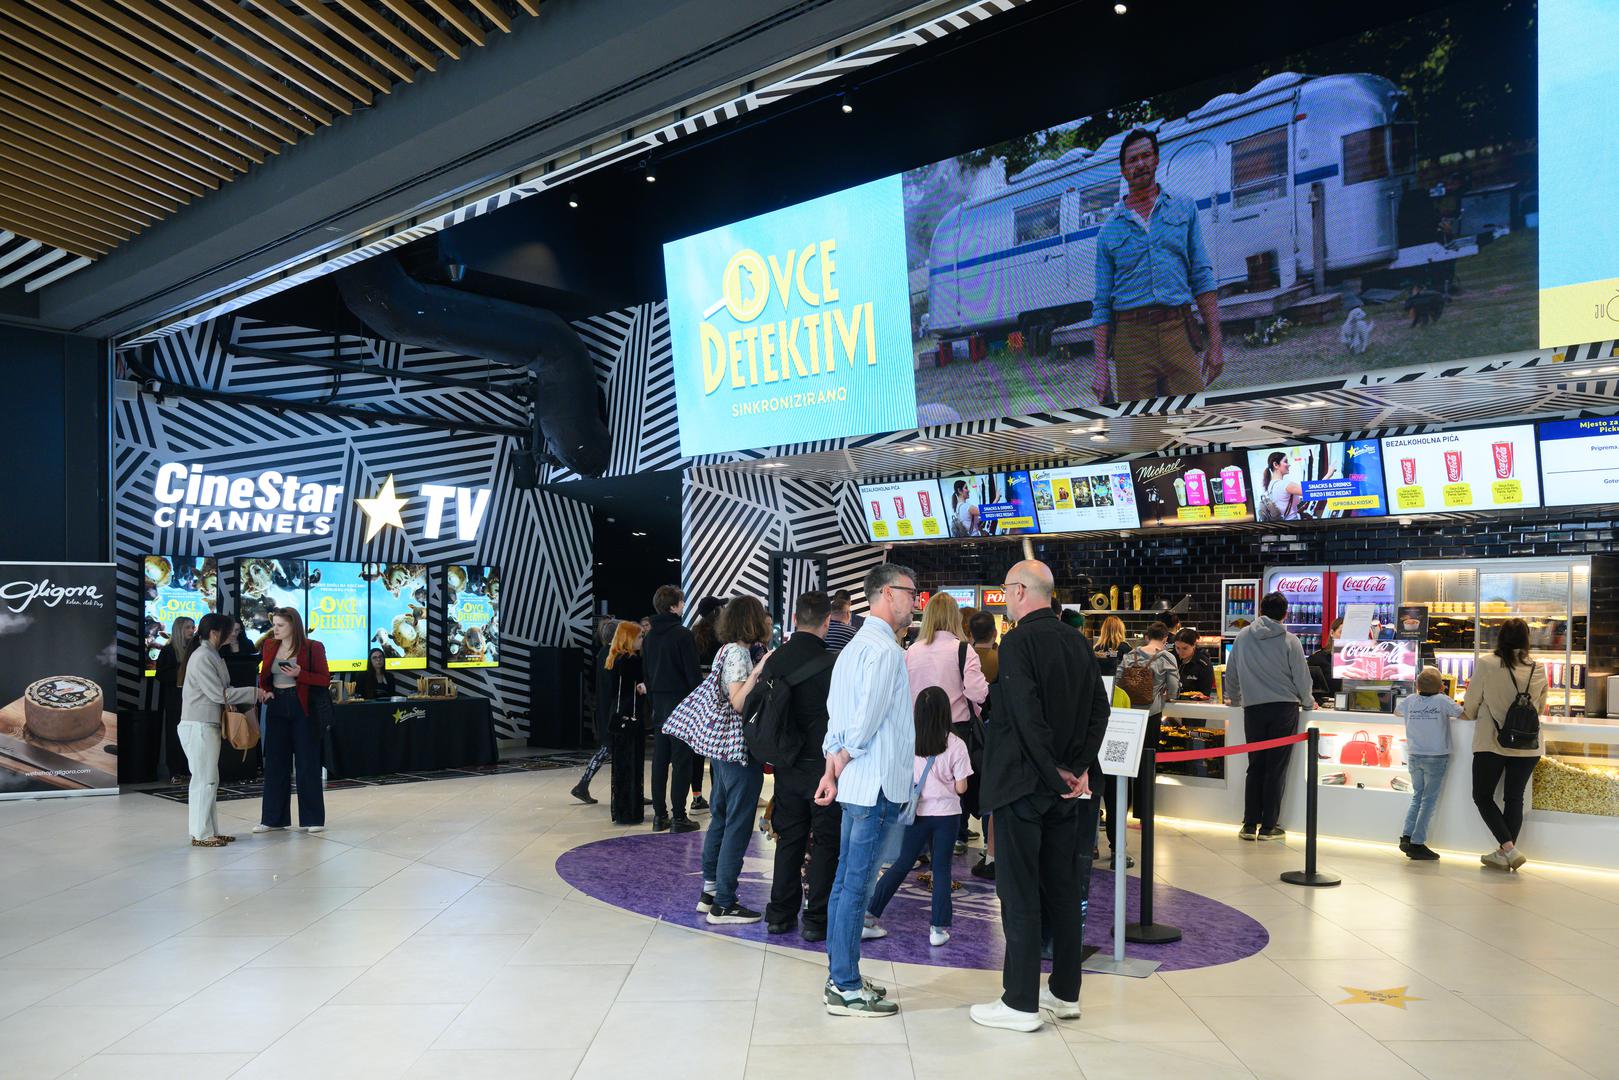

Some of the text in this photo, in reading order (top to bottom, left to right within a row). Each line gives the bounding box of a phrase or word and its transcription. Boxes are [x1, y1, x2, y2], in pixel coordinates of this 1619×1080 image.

[722, 238, 839, 323] OVCE
[700, 301, 877, 397] DETEKTIVI
[731, 387, 847, 417] SINKRONIZIRANO
[1580, 420, 1607, 429] Mjesto
[1386, 437, 1441, 447] BEZALKOHOLNA
[1136, 458, 1182, 483] Michael
[154, 462, 491, 541] CineStar TV
[153, 507, 331, 535] CHANNELS
[1277, 577, 1320, 593] Coca-Cola
[1342, 575, 1388, 592] Coca-Cola
[321, 596, 357, 613] OVCE
[310, 610, 366, 630] DETEKTIVI
[1341, 641, 1408, 664] Coca-Cola
